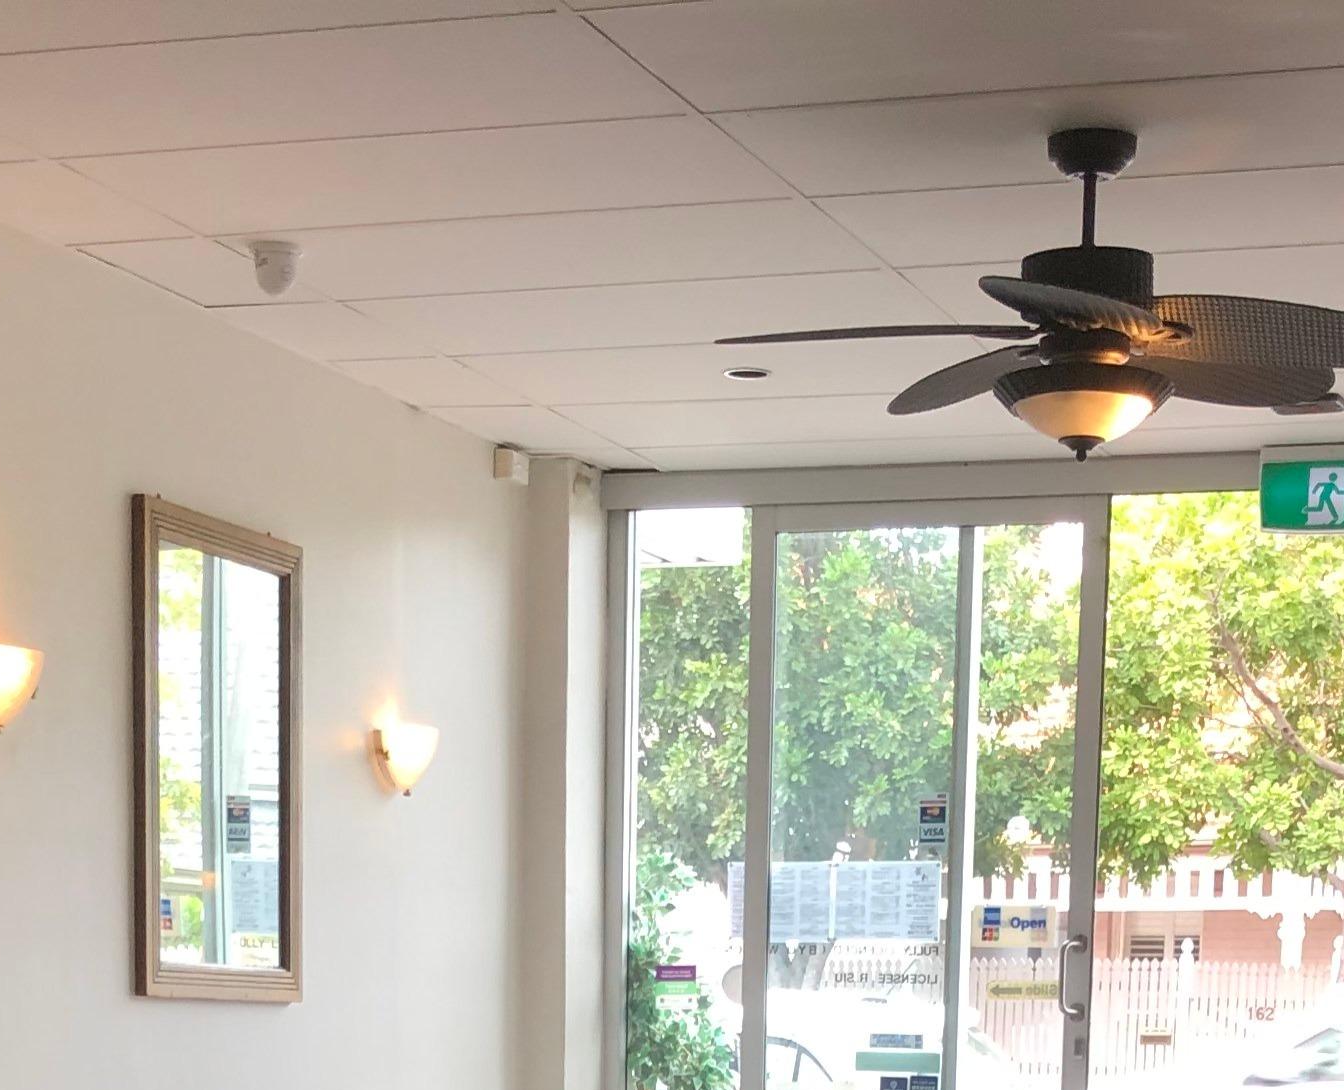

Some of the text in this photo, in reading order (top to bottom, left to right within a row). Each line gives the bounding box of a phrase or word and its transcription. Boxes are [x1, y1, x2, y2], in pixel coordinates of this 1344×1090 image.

[922, 828, 945, 836] VISA
[1010, 916, 1047, 931] Open
[1248, 1006, 1275, 1021] 162
